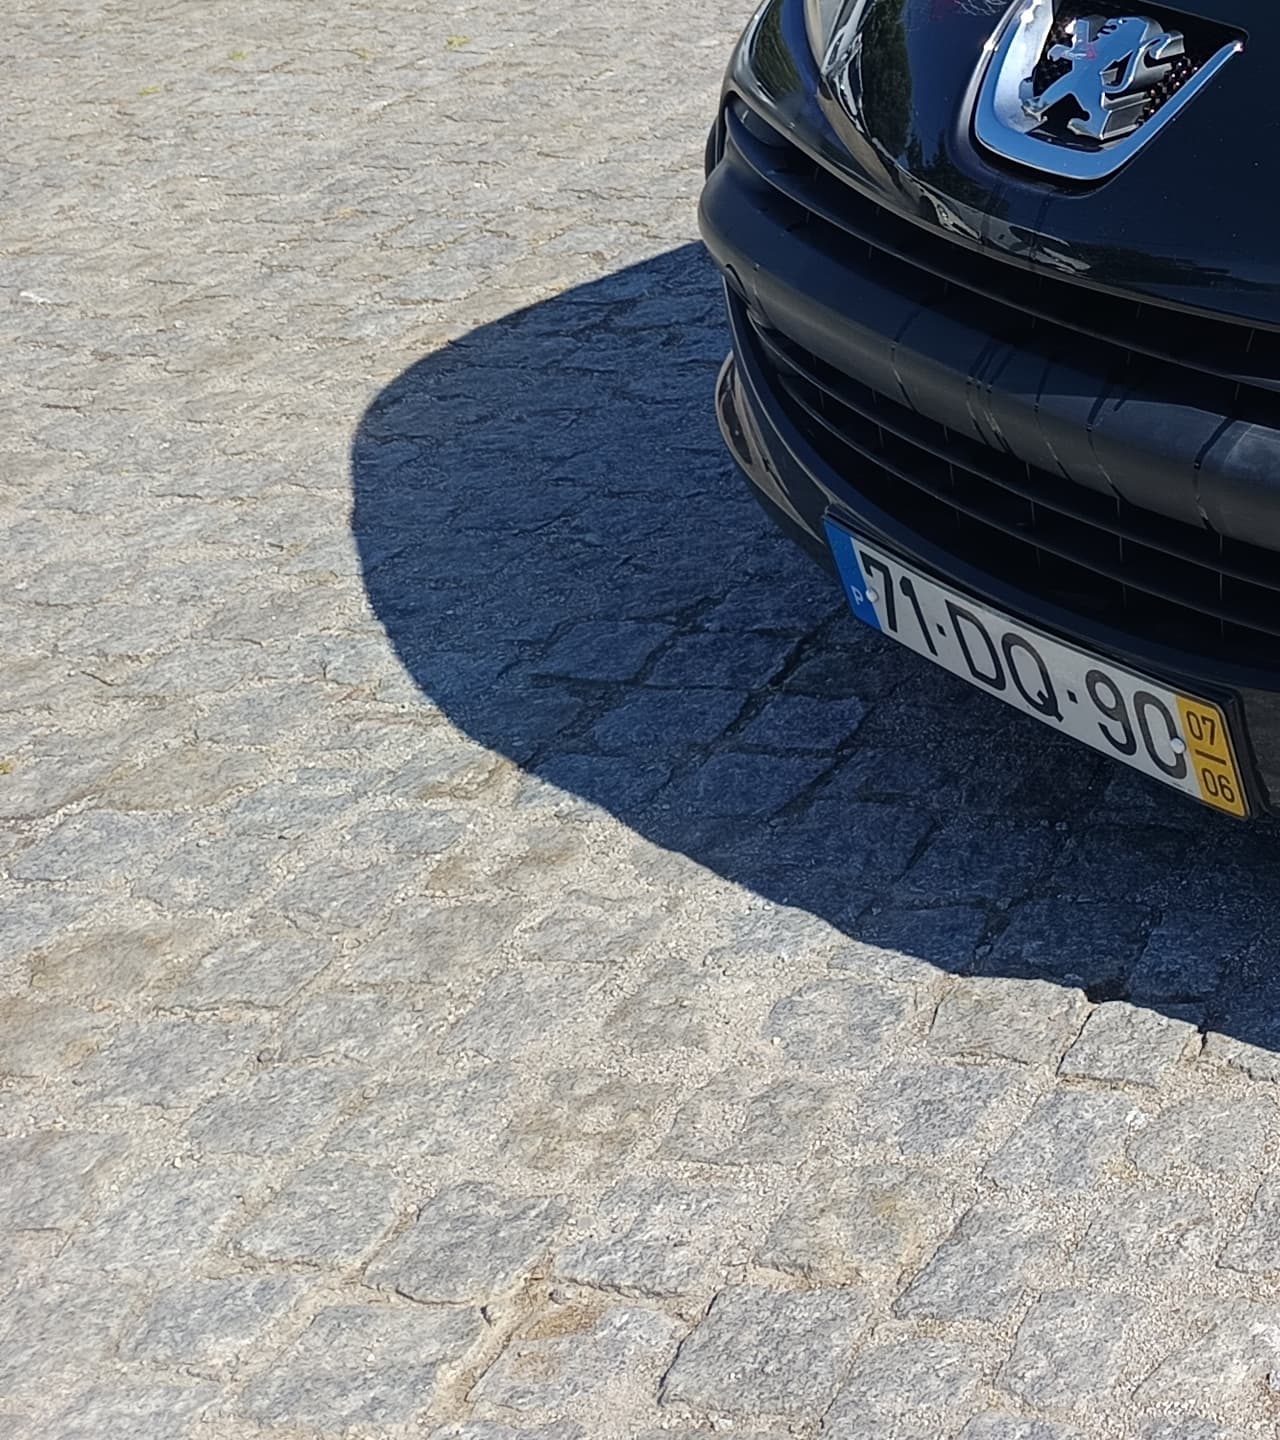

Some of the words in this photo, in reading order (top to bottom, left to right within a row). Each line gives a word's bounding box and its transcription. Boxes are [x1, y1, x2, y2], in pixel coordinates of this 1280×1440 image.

[851, 584, 865, 606] P
[1185, 709, 1218, 747] 07
[1201, 768, 1236, 804] 06
